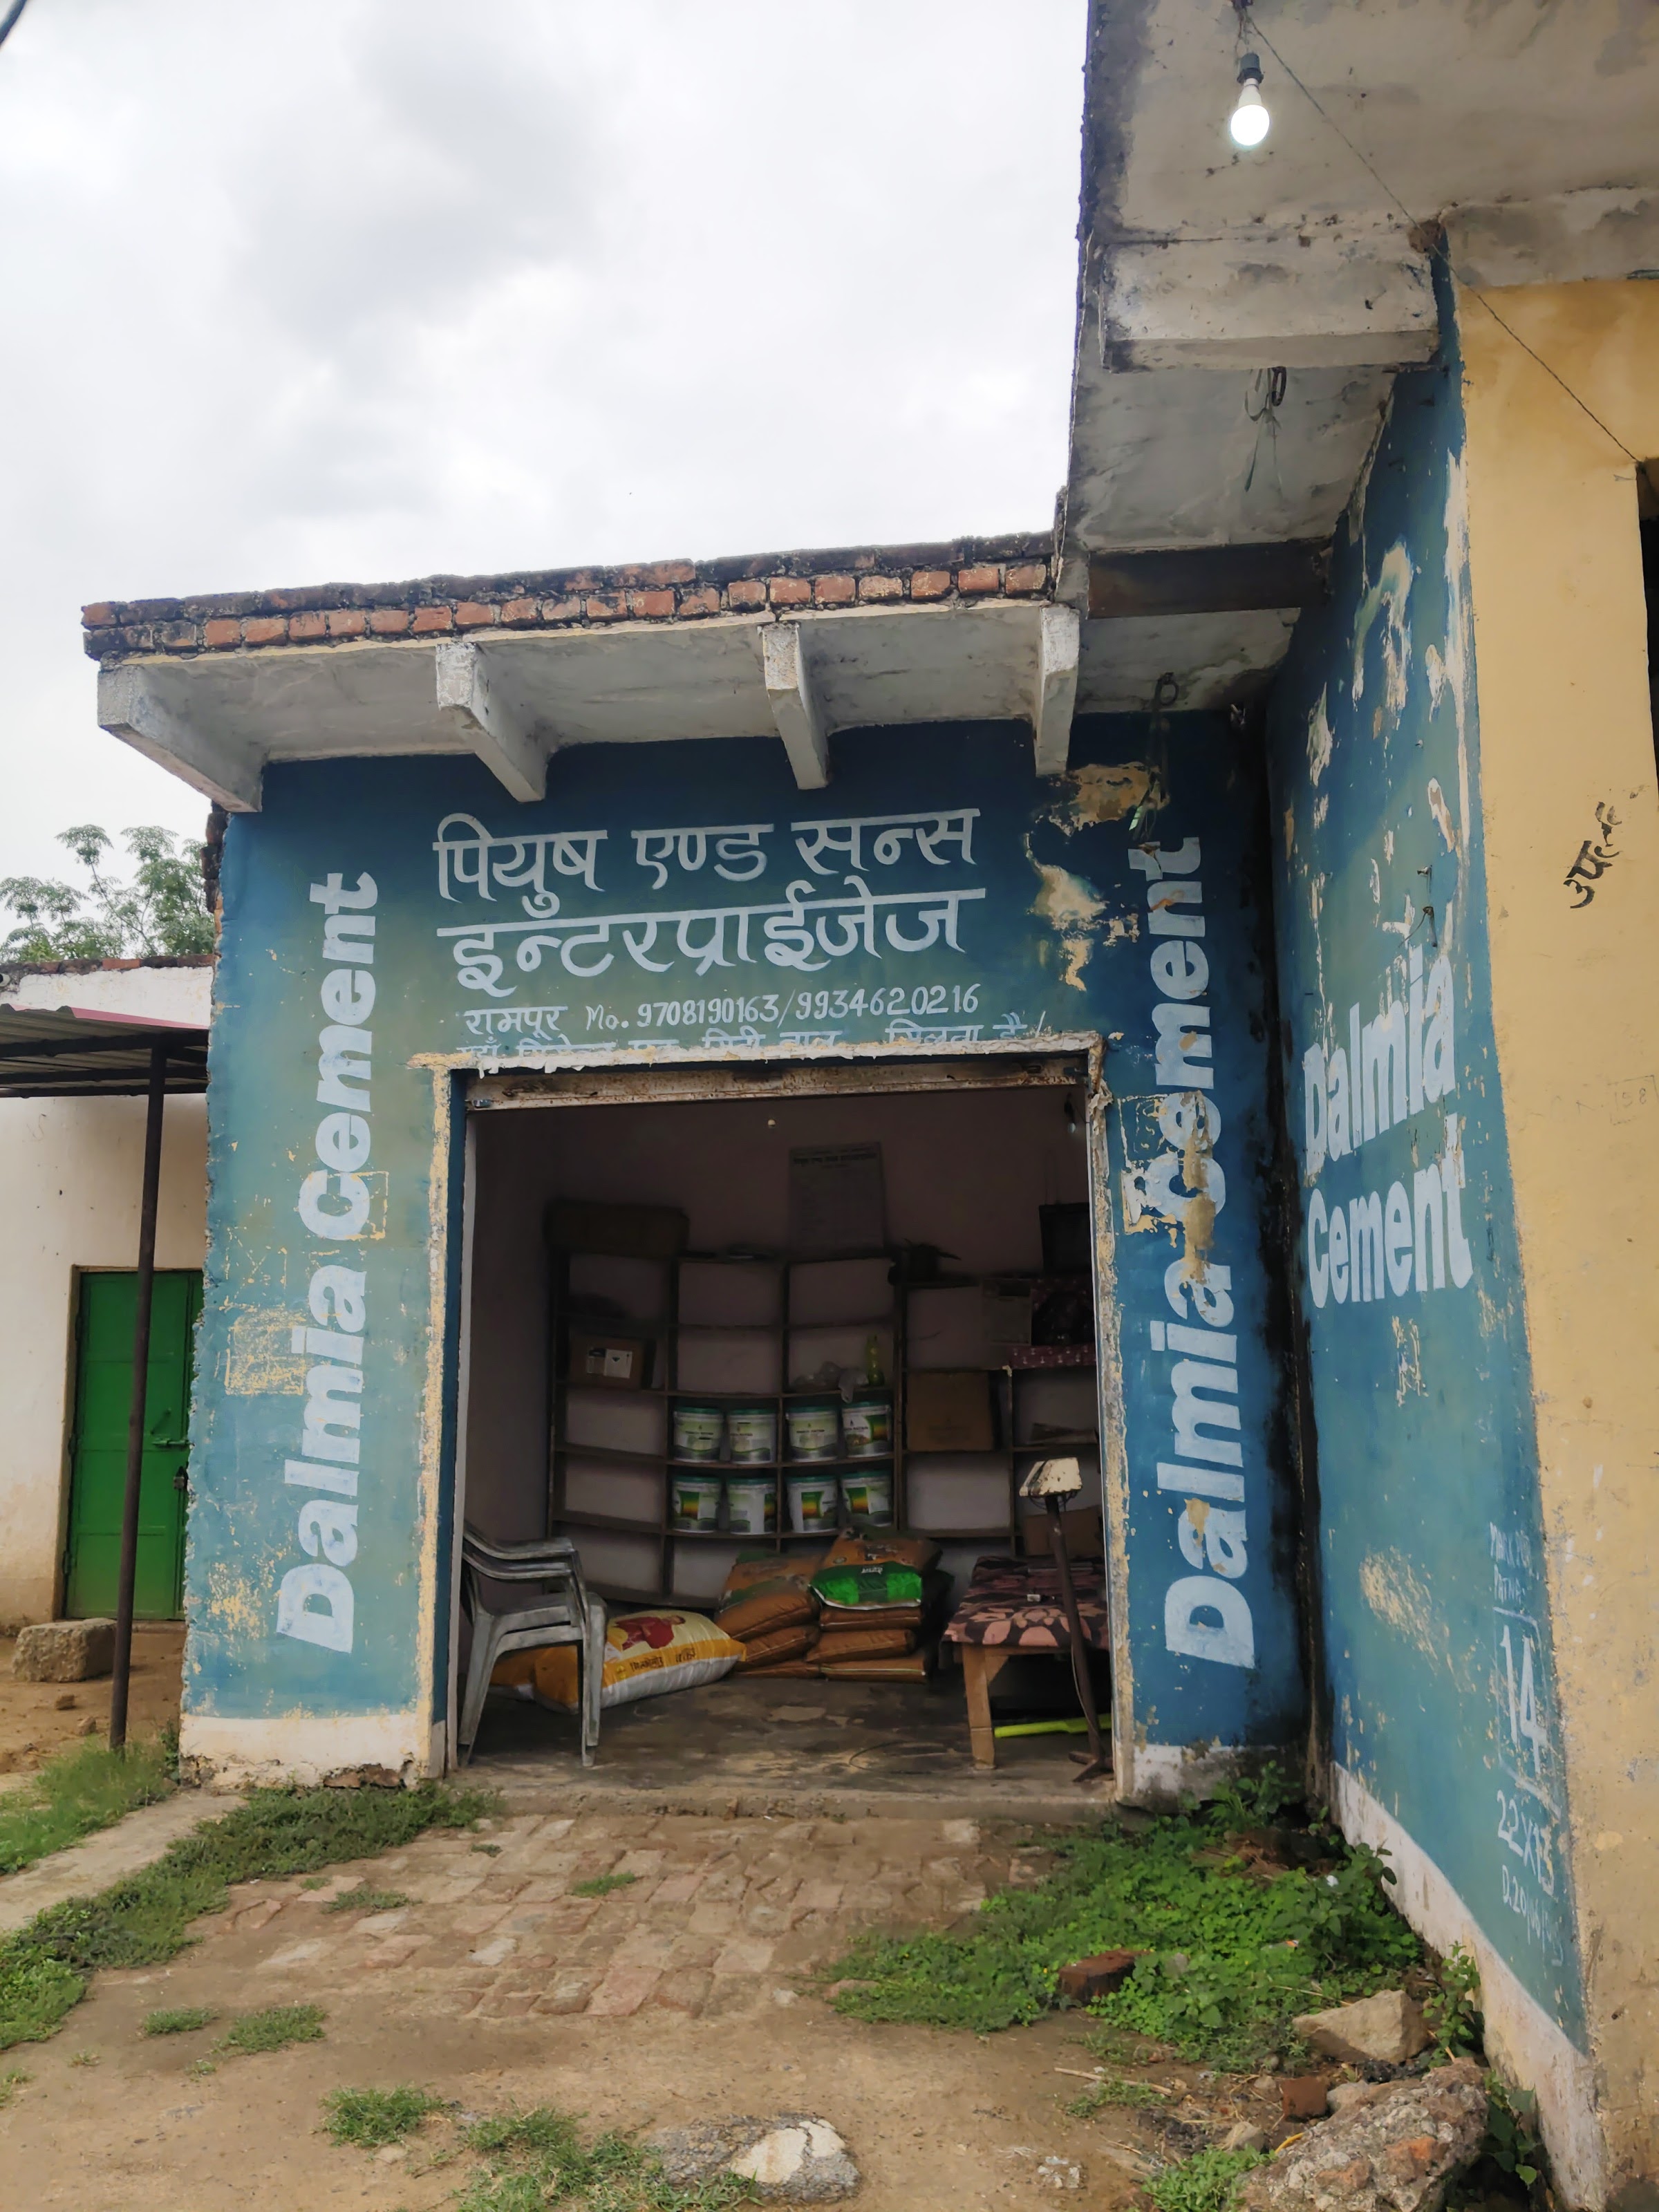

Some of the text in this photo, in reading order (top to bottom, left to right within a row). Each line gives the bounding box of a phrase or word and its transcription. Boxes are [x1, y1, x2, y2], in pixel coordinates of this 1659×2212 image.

[630, 823, 775, 890] एण्ड
[791, 807, 980, 876] सन्स
[1303, 944, 1456, 1177] Dalmia
[277, 871, 379, 1653] Dalmia Cement
[1128, 836, 1255, 1669] Dalmia Cement
[1307, 1112, 1473, 1309] Cement
